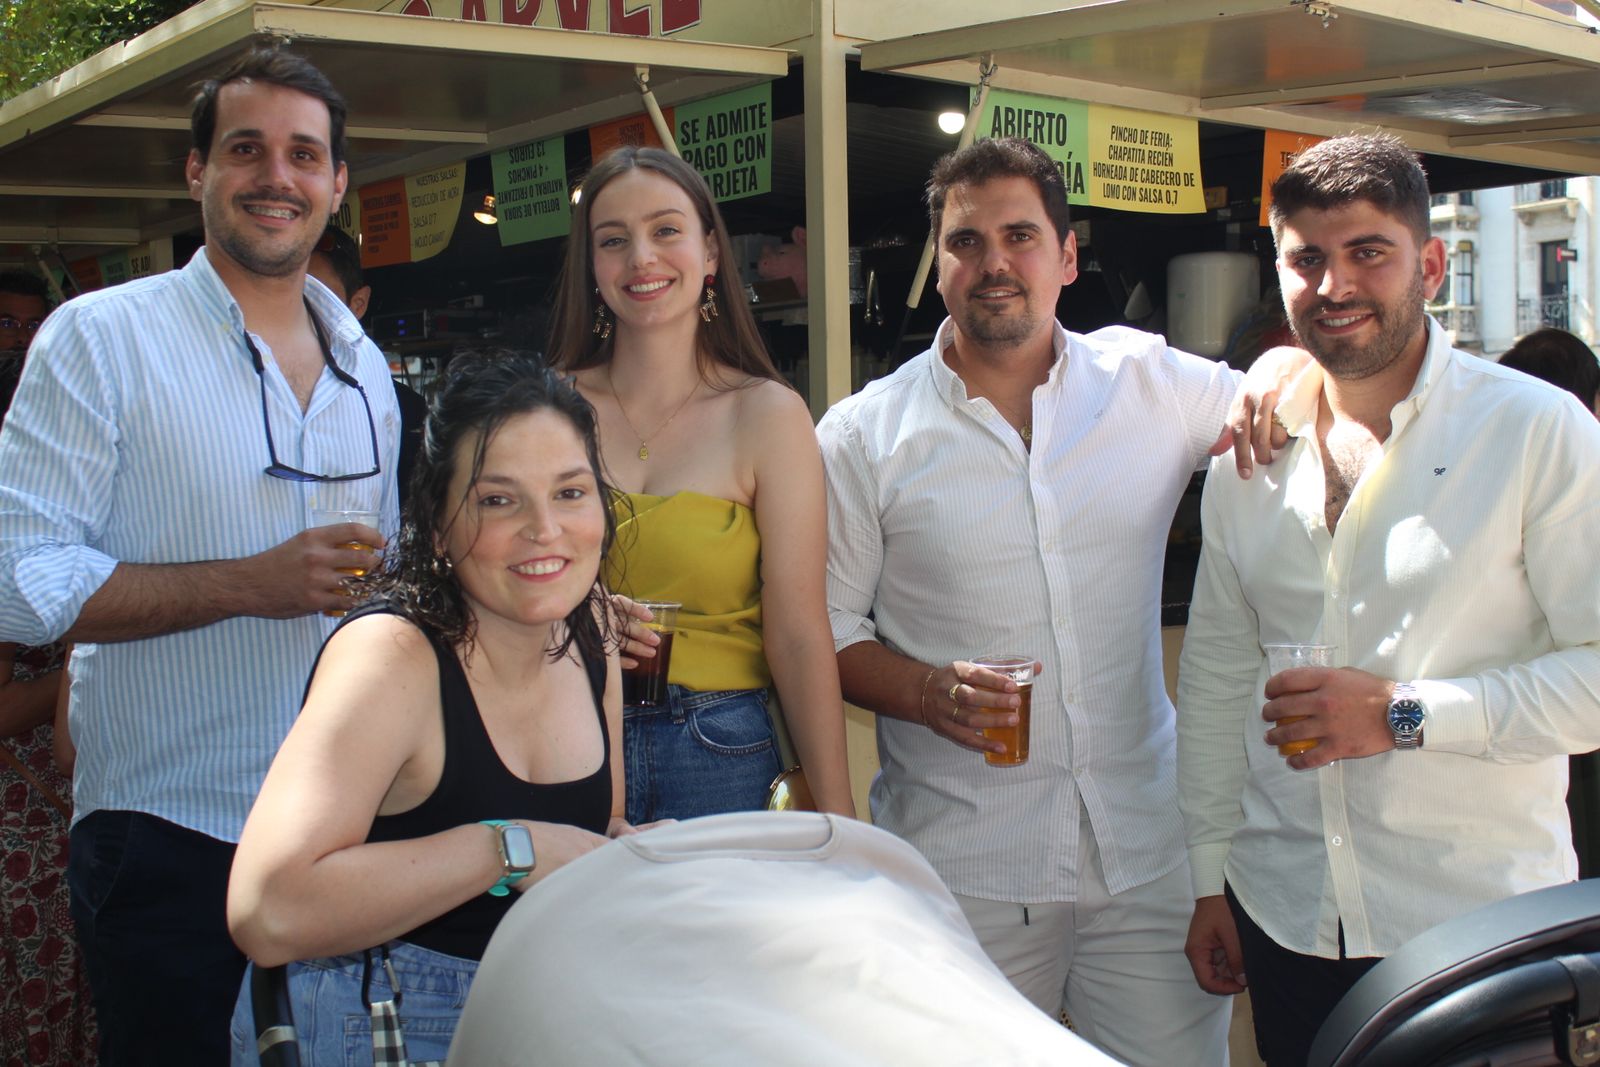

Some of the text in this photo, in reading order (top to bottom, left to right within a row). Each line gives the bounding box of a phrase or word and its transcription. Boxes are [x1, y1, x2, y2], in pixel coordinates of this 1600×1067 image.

[680, 118, 700, 146] SE
[706, 102, 767, 142] ADMITE
[990, 105, 1067, 146] ABIERTO
[1110, 125, 1173, 148] PINCHO DE FERIA:
[508, 143, 535, 164] EUROS
[682, 133, 766, 171] PAGO CON
[1108, 144, 1174, 167] CHAPATITA RECIÉN
[508, 164, 537, 184] PINCHOS
[1093, 161, 1195, 187] HORNEADA DE CABECERO DE
[498, 186, 528, 205] FRIZZANTE
[535, 178, 563, 197] NATURAL
[1103, 182, 1120, 200] LOMO
[1122, 185, 1137, 202] CON
[1138, 187, 1163, 204] SALSA
[504, 198, 560, 221] BOTELLA DE SIDRA
